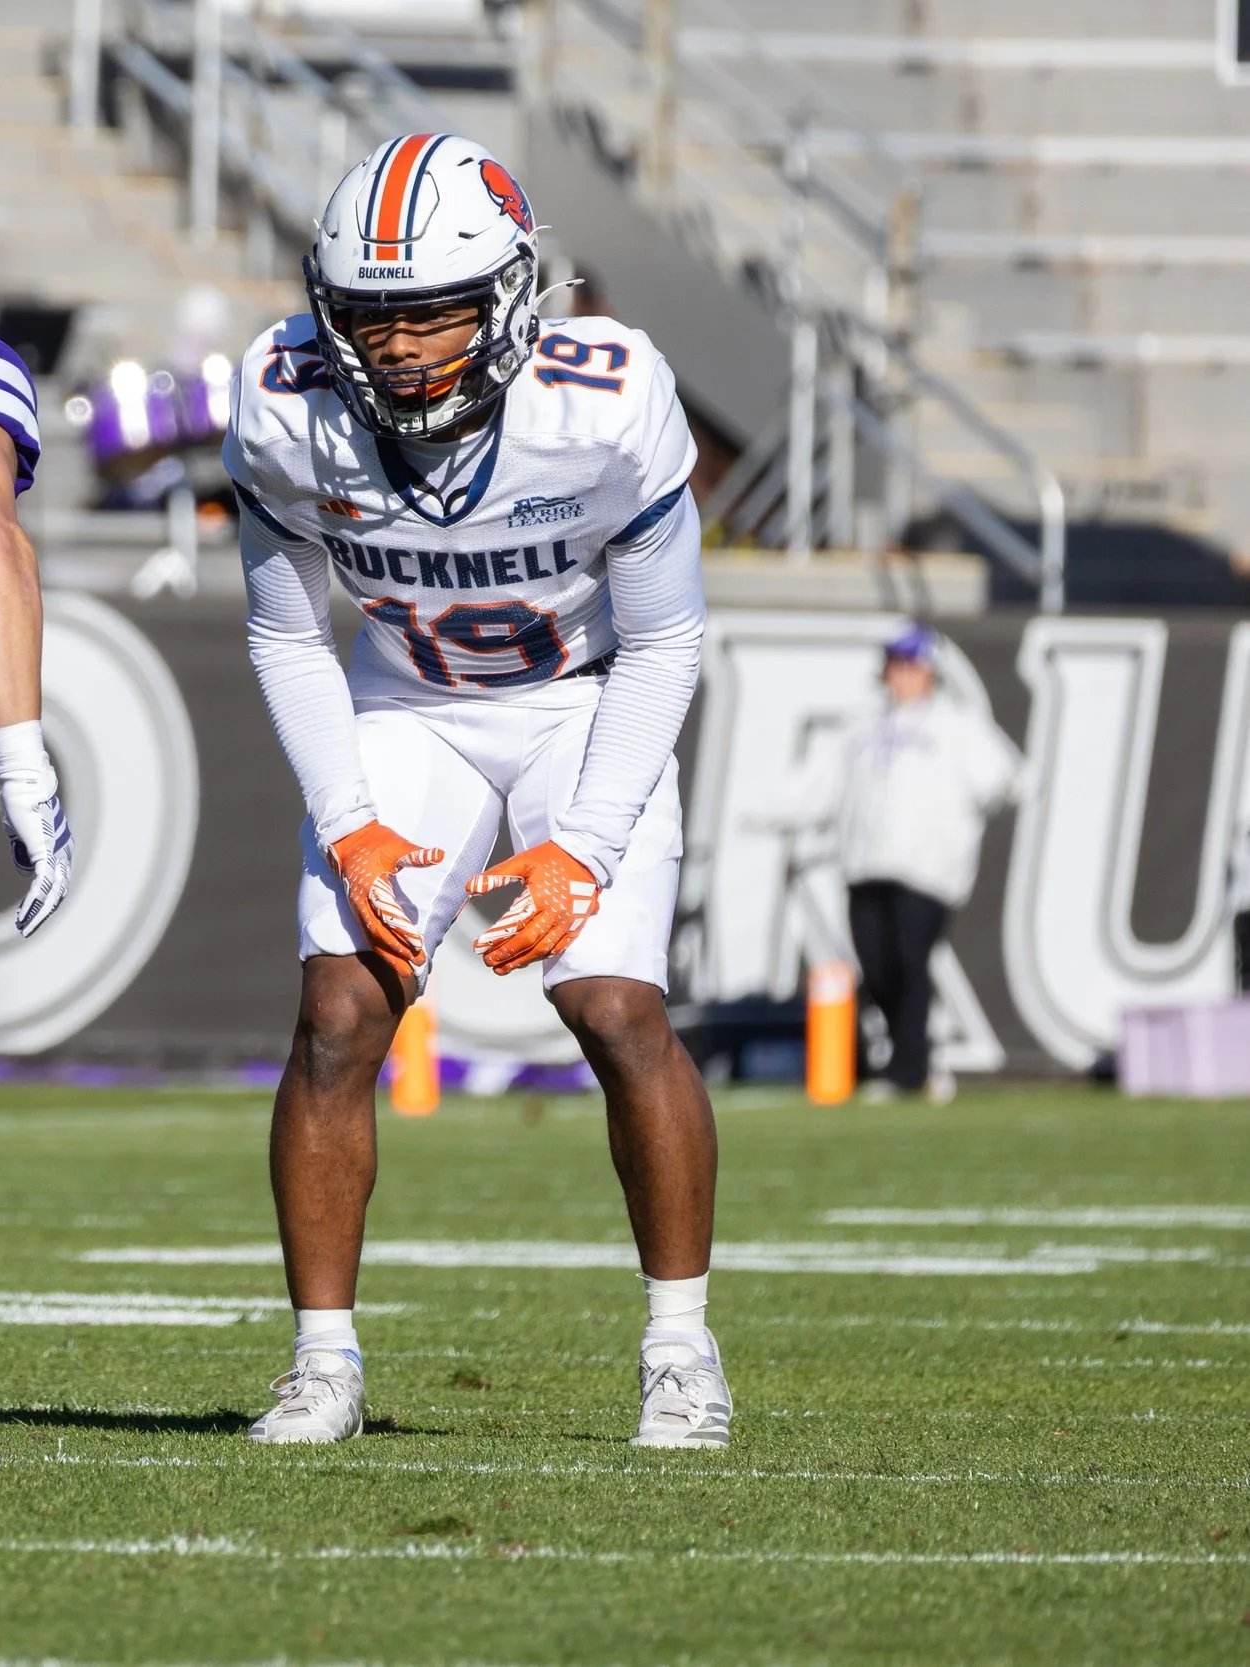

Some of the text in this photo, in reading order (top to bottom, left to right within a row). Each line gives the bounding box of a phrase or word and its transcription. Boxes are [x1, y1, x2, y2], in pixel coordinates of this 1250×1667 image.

[358, 266, 415, 279] BUCKNELL
[533, 332, 630, 396] 19
[507, 507, 586, 529] LEAGUE
[321, 530, 578, 589] BUCKNELL
[362, 596, 570, 689] 19
